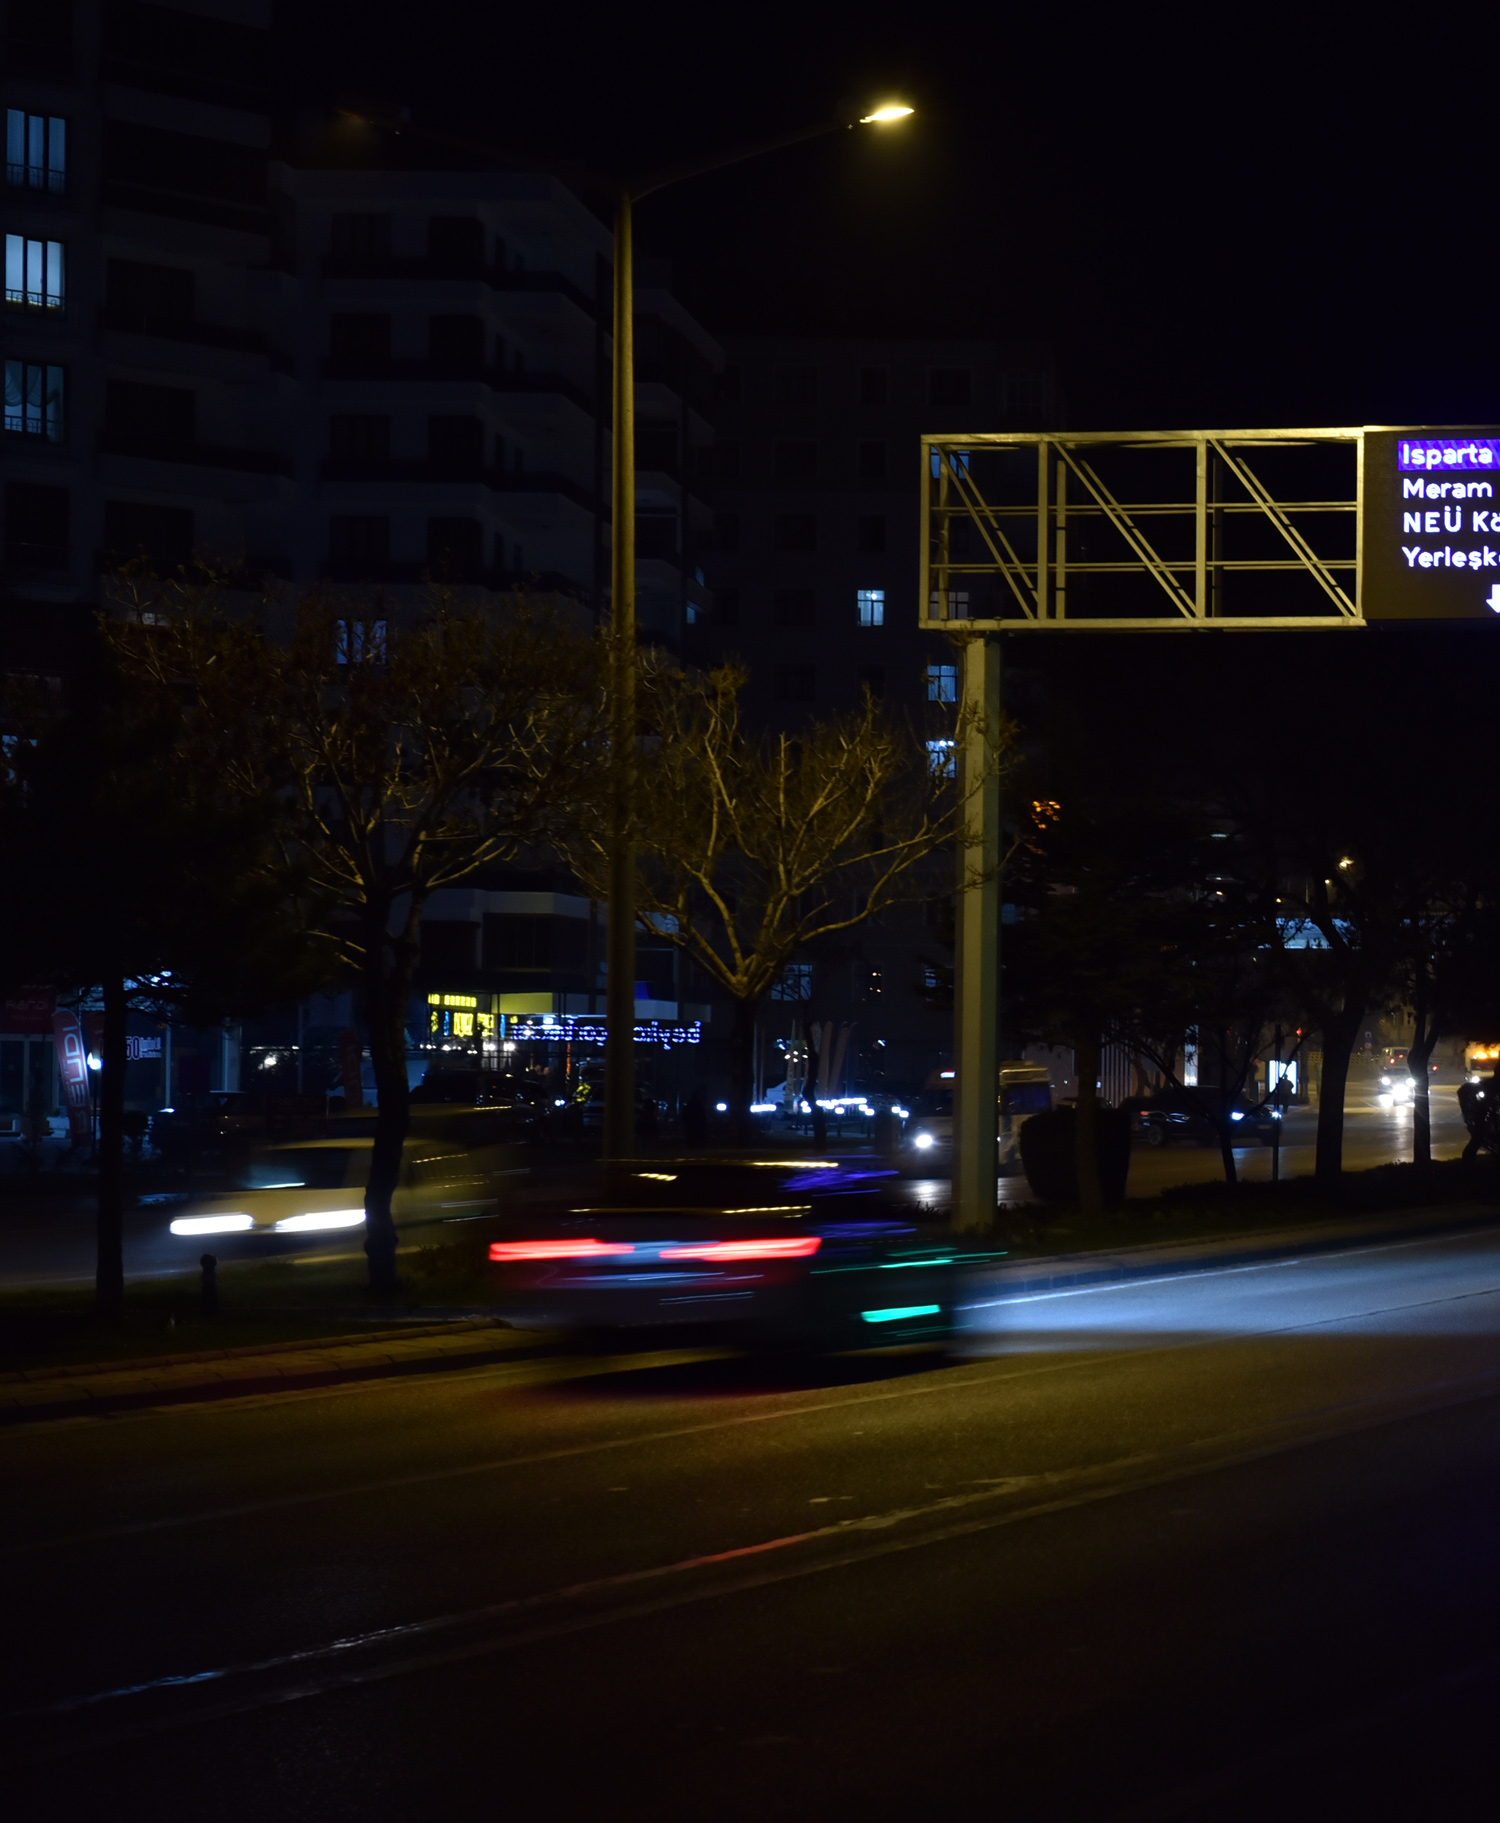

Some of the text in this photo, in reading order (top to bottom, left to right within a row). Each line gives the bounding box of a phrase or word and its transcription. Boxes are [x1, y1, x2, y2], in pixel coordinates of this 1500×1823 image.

[1402, 443, 1494, 471] Isparta
[1402, 477, 1493, 500] Meram
[1403, 505, 1462, 533] NEÜ
